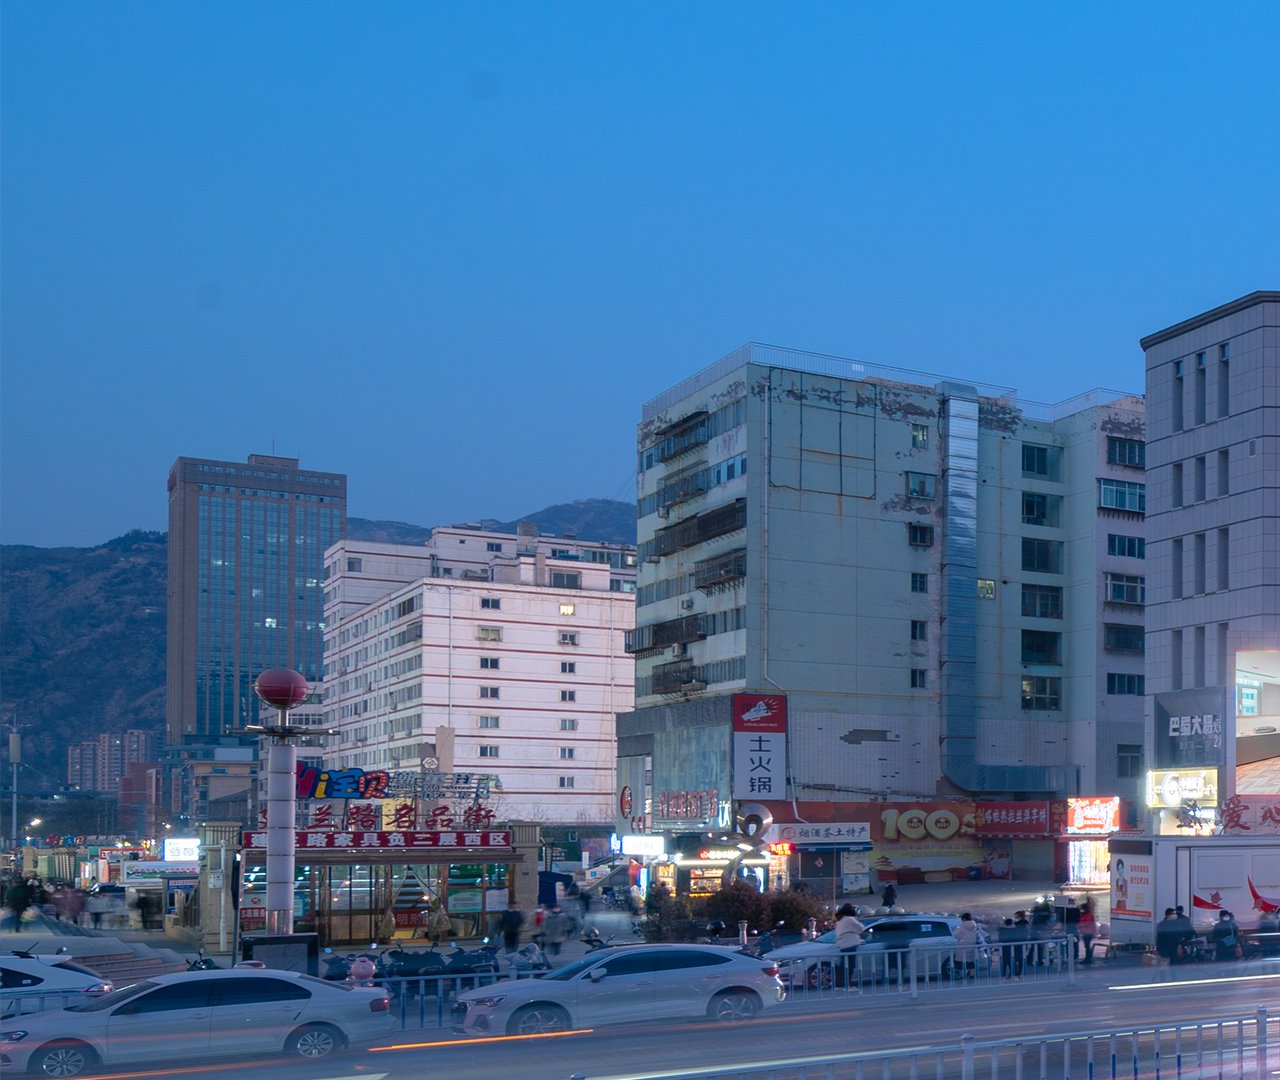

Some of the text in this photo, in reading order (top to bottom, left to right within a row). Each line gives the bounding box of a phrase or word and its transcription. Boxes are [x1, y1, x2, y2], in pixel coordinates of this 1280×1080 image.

[798, 826, 866, 839] 烟酒茶土特产
[251, 832, 507, 848] 建路家具负二层西区
